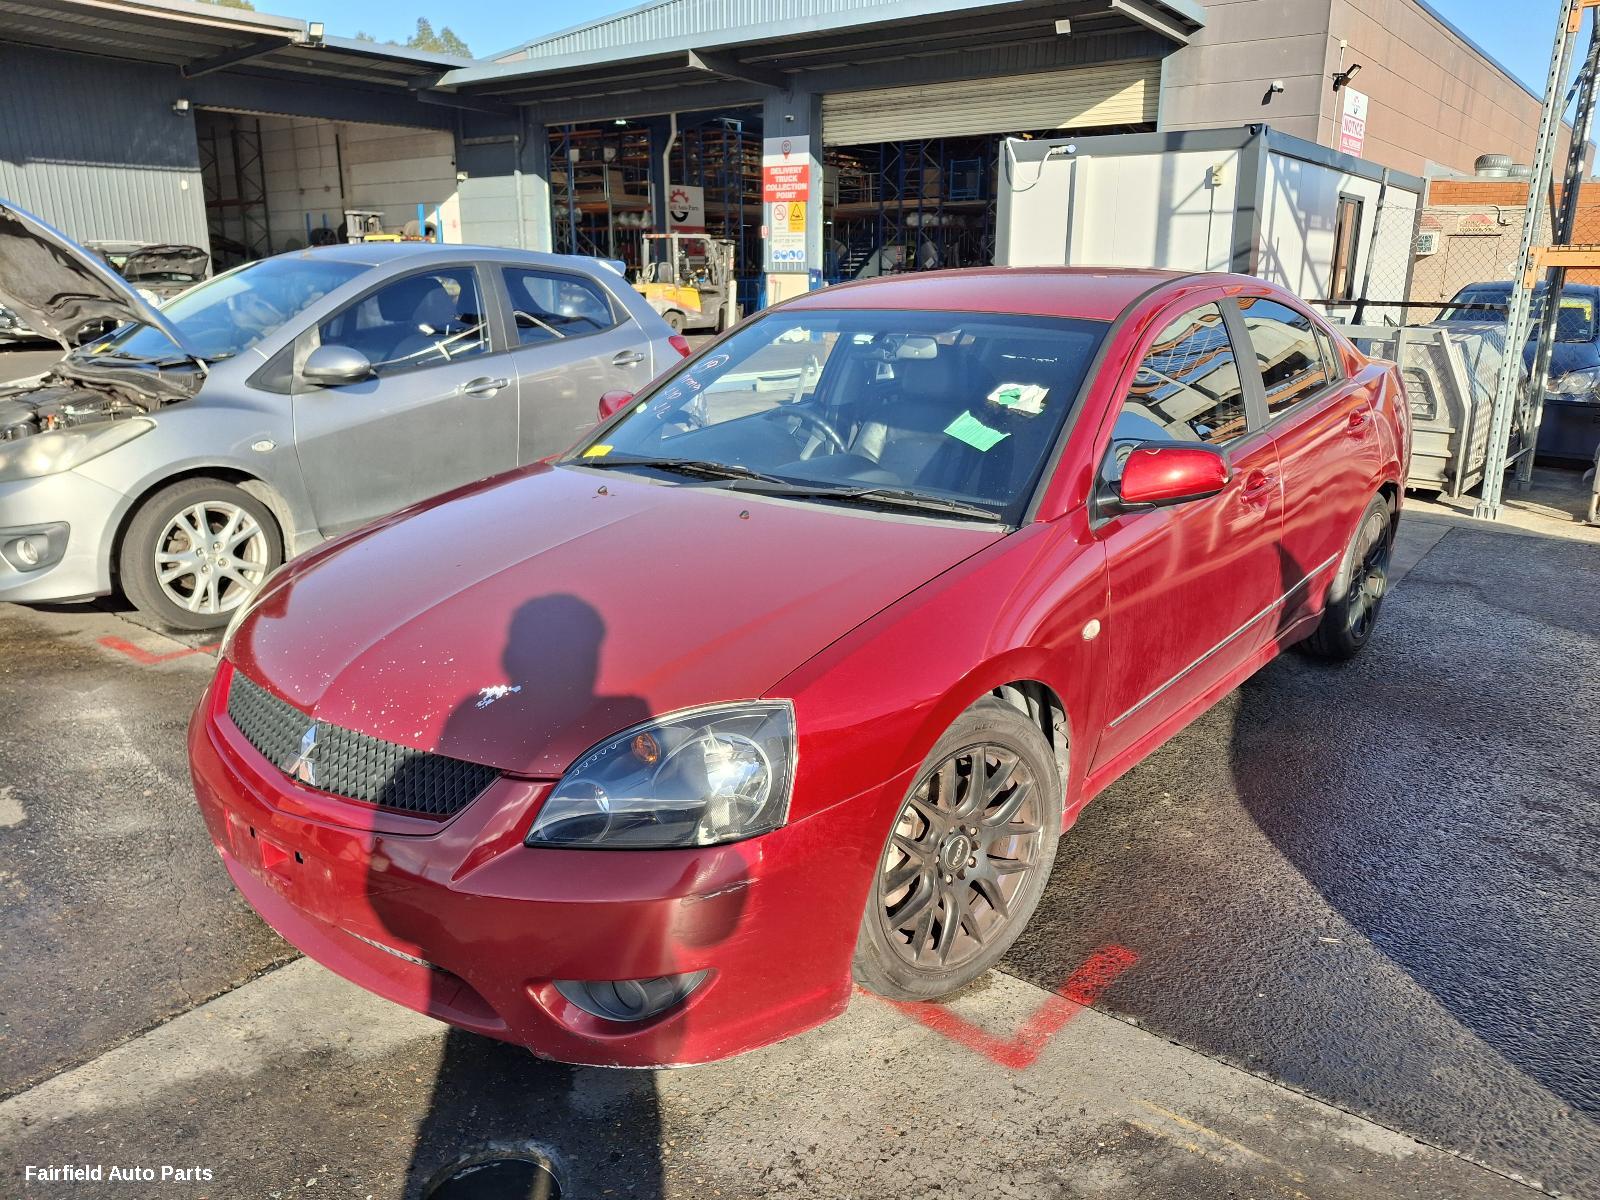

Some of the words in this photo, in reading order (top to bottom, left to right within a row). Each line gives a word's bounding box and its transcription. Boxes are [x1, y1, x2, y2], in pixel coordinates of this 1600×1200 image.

[1343, 117, 1363, 137] NOTICE
[770, 166, 803, 175] DELIVERY
[775, 175, 799, 183] TRUCK
[765, 183, 808, 191] COLLECTION
[775, 191, 797, 199] POINT
